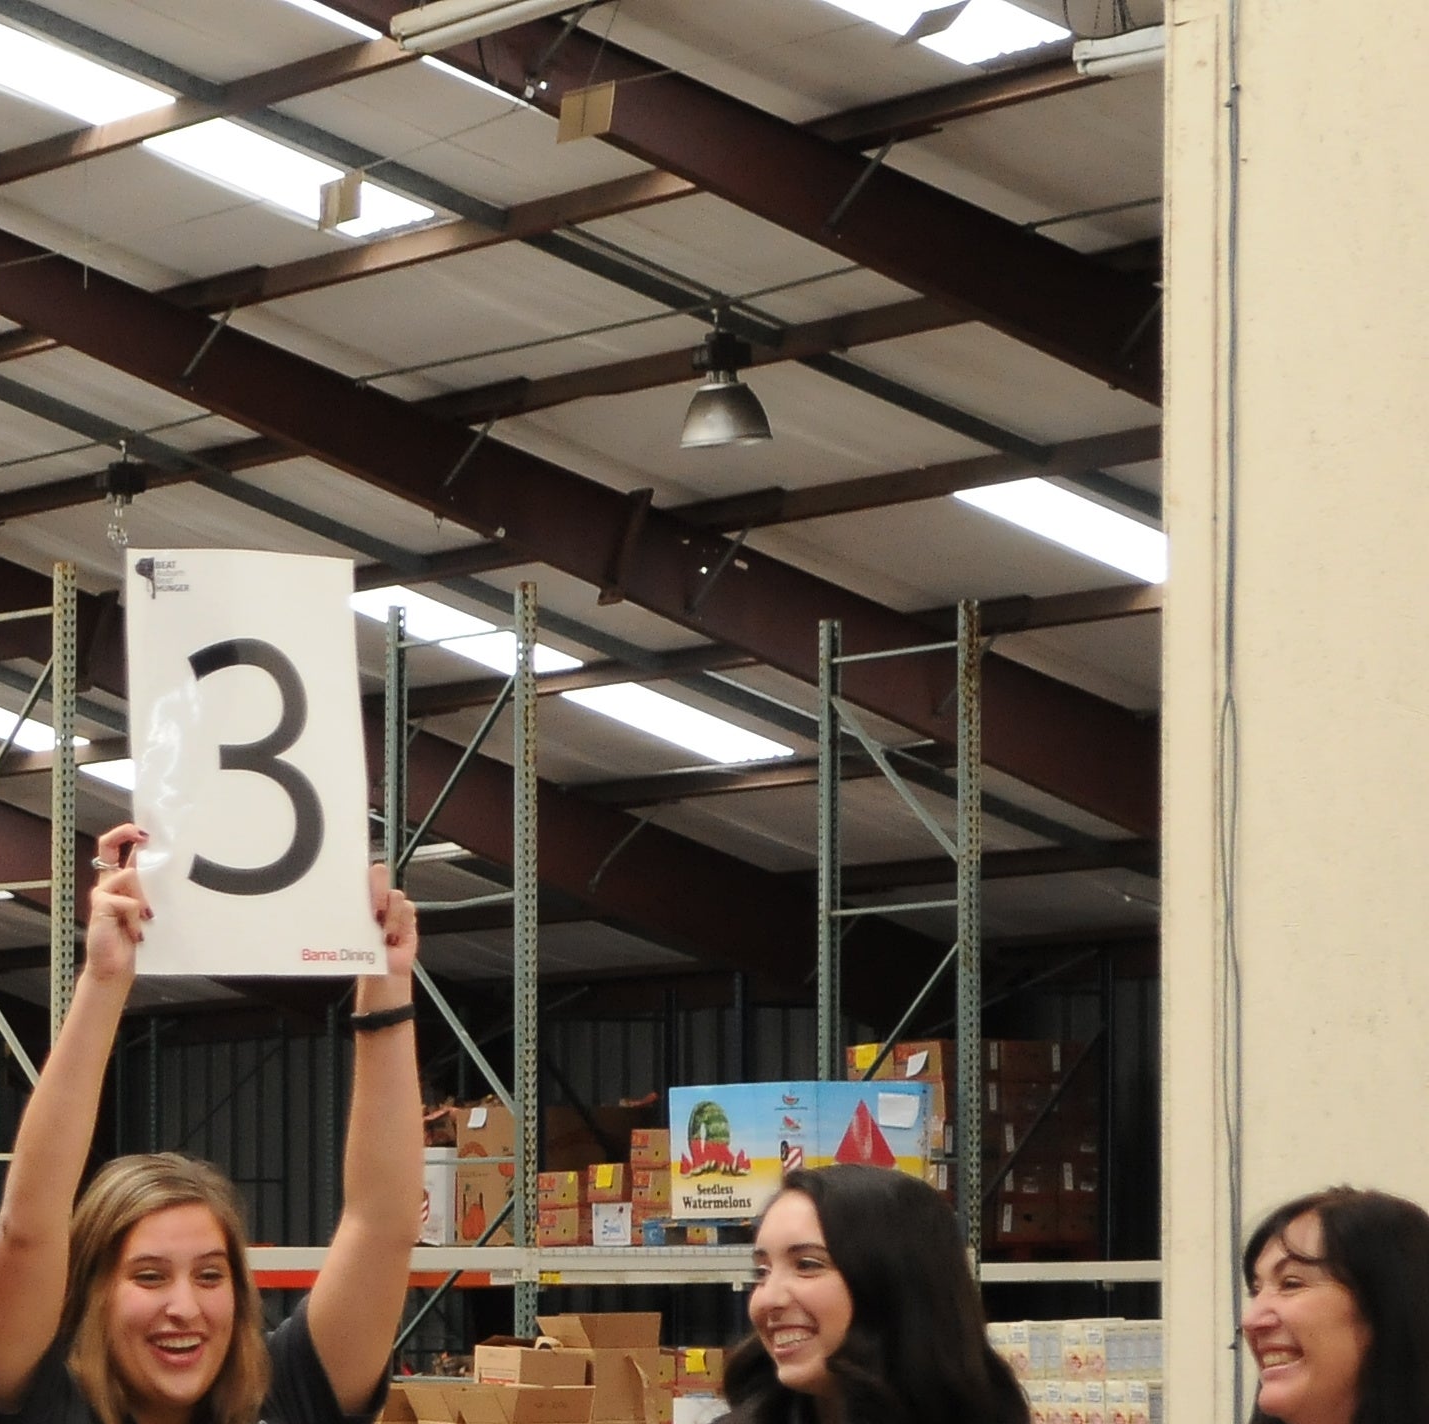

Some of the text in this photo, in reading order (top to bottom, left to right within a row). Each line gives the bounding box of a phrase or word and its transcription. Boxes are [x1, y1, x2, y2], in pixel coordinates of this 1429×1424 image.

[155, 561, 176, 569] BEAT
[189, 638, 323, 895] 3
[302, 949, 375, 964] Bama Dining
[697, 1184, 734, 1195] Seedless
[682, 1196, 752, 1209] Watermelons
